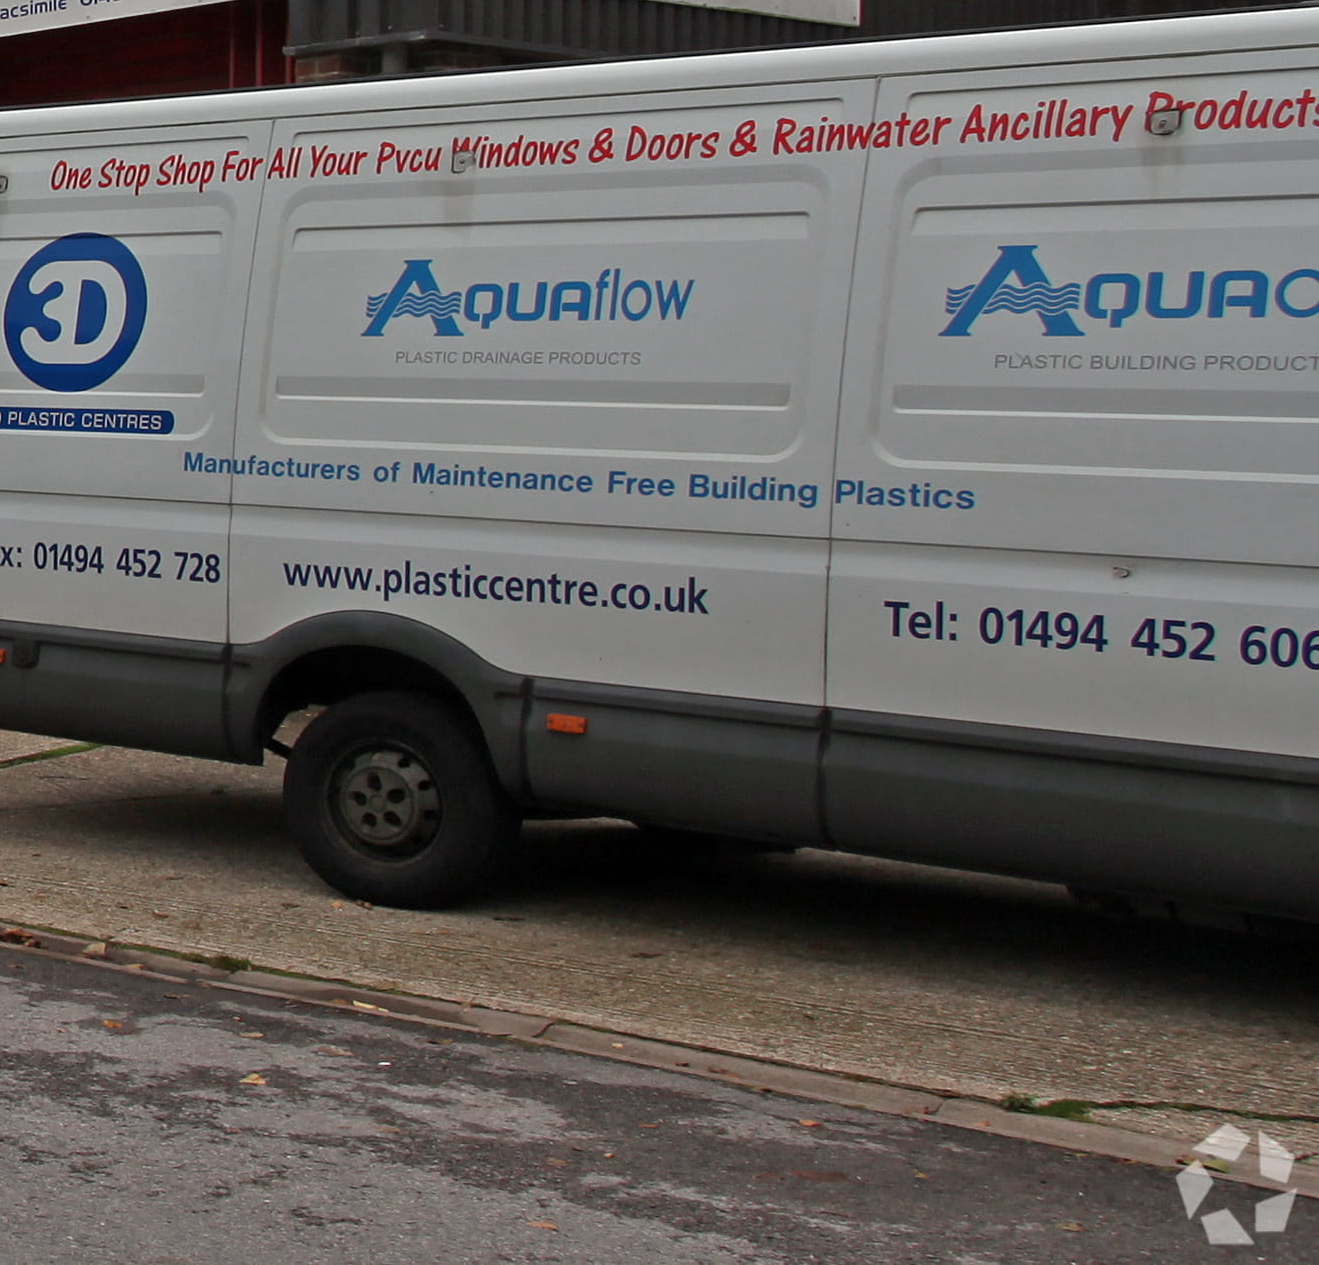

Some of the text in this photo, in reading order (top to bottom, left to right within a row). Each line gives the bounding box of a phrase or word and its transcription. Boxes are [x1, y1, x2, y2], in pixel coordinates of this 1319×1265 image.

[50, 159, 92, 191] One
[98, 156, 150, 196] Stop
[156, 154, 216, 194] Shop
[221, 149, 264, 184] For
[266, 147, 303, 181] All
[309, 145, 368, 178] Your
[375, 141, 442, 175] Pvcu
[451, 134, 580, 171] Windows
[588, 127, 614, 164] &
[625, 125, 720, 163] Doors
[728, 120, 758, 157] &
[772, 112, 953, 156] Rainwater
[959, 99, 1134, 144] Ancillary
[19, 260, 128, 365] 3D
[395, 350, 642, 366] PLASTIC DRAINAGE PRODUCTS
[994, 354, 1083, 370] PLASTIC
[1090, 355, 1196, 370] BUILDING
[7, 411, 75, 428] PLASTIC
[80, 413, 162, 430] CENTRES
[183, 452, 975, 510] Manufacturers of Maintenance Free Building Plastics
[33, 542, 105, 575] 01494
[116, 547, 162, 579] 452
[174, 551, 221, 583] 728
[283, 560, 709, 614] www.plasticcentre.co.uk
[883, 600, 959, 642] Tel:
[978, 607, 1108, 652] 01494
[1130, 618, 1216, 661] 452
